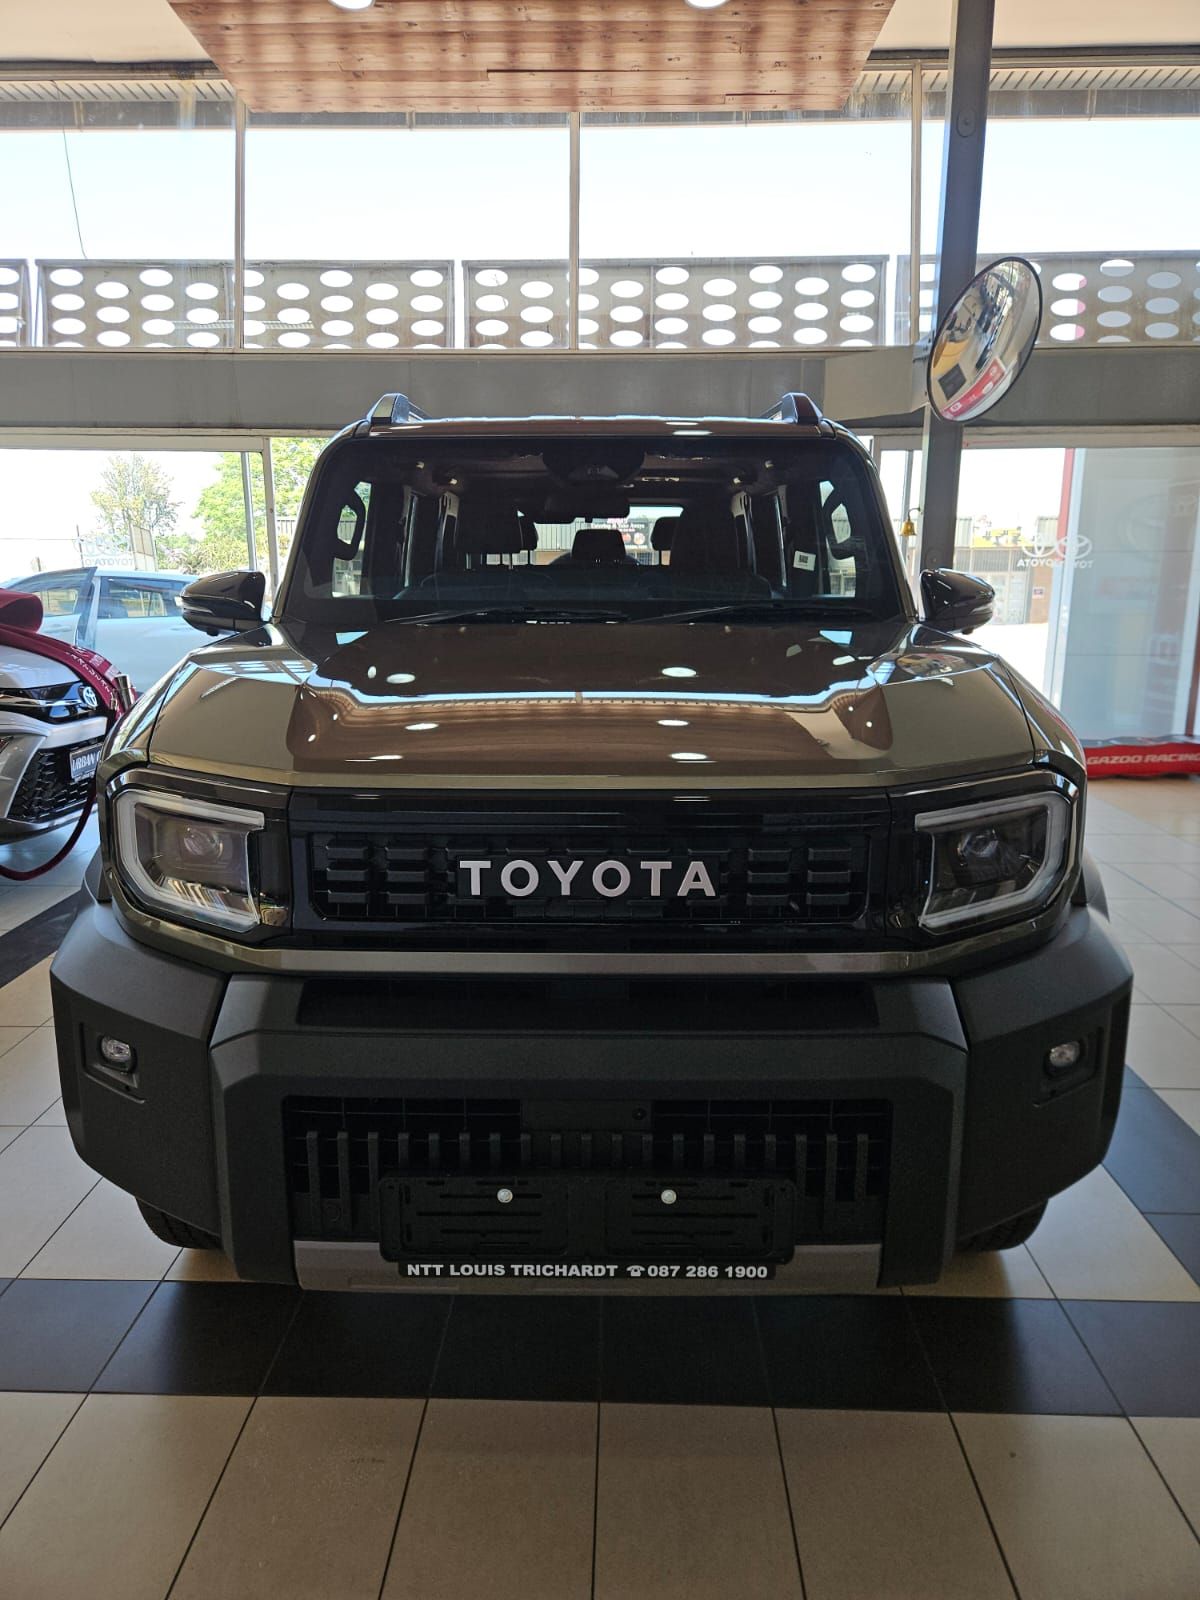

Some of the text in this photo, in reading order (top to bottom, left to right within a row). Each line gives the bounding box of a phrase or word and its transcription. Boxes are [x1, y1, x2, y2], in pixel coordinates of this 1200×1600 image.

[72, 751, 96, 772] URBAN
[1087, 755, 1142, 765] GAZOO
[459, 859, 716, 898] TOYOTA
[407, 1264, 768, 1279] NTT LOUIS TRICHARDT 087 286 1900
